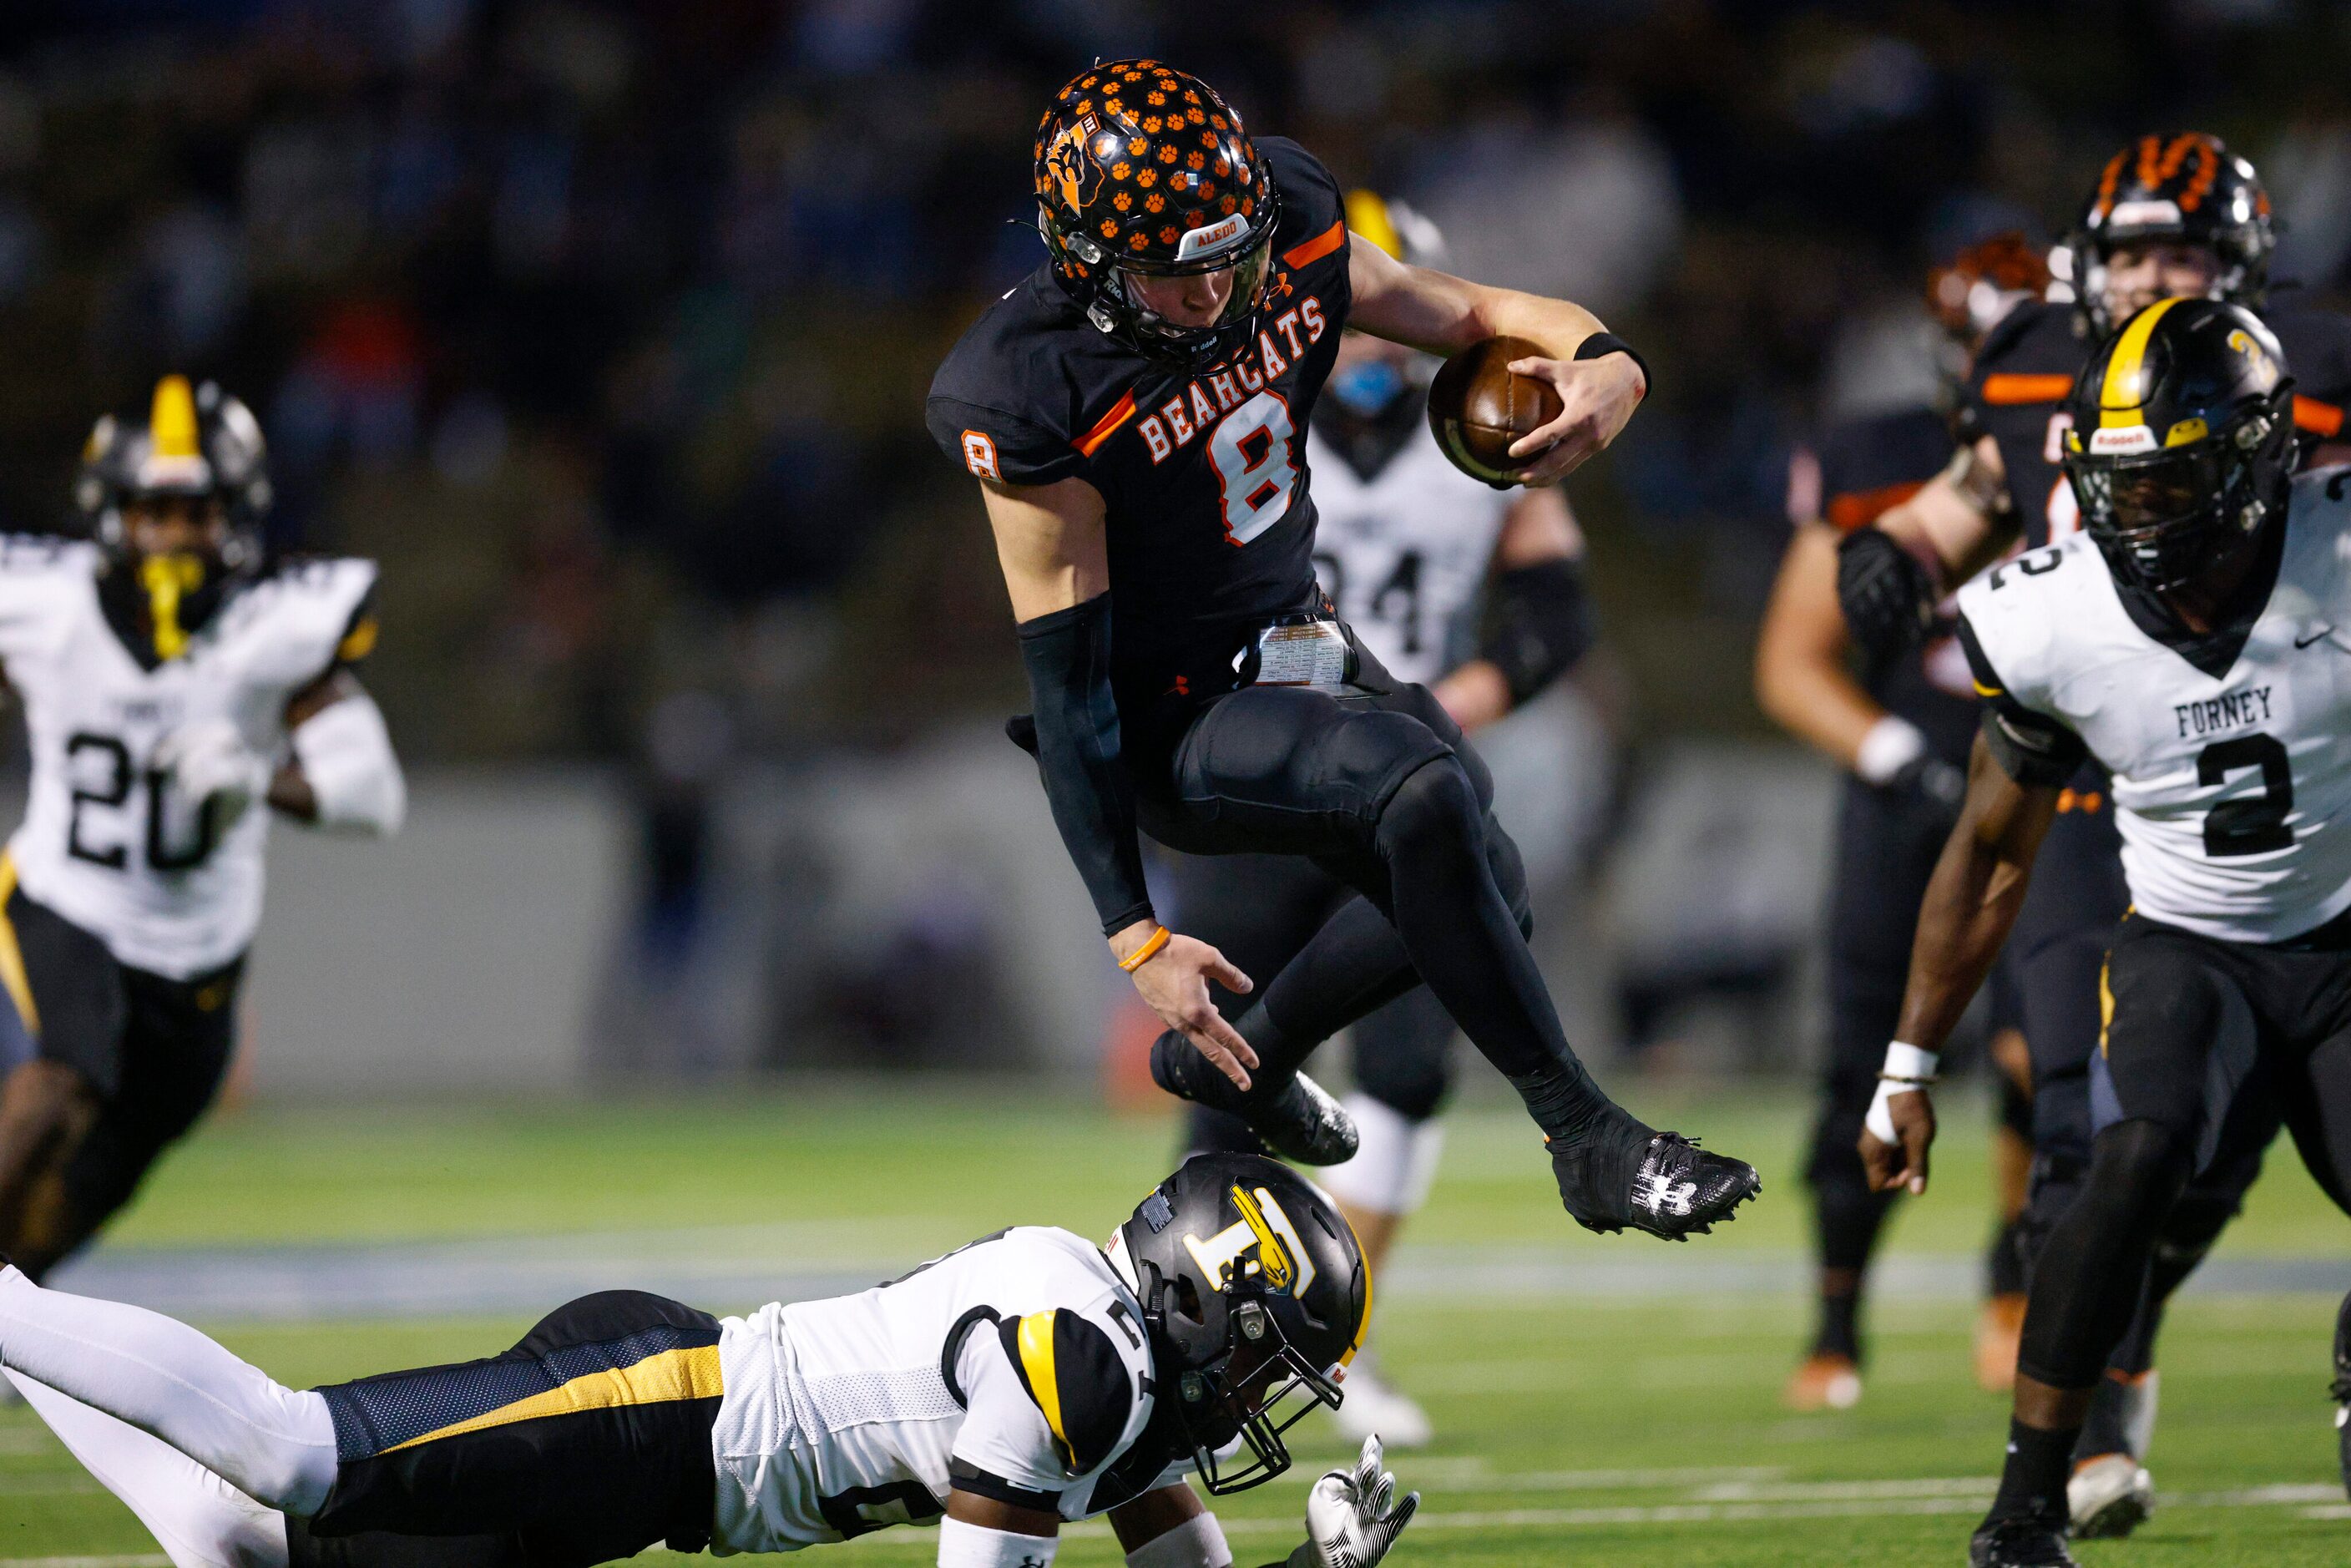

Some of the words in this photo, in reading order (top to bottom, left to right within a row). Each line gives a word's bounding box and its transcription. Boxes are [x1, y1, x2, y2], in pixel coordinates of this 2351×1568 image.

[1197, 221, 1237, 247] ALEDO
[1136, 295, 1326, 466] BEARCATS
[960, 429, 1005, 484] 8
[1205, 387, 1299, 548] 8
[2173, 685, 2273, 739] FORNEY
[2197, 732, 2295, 857] 2
